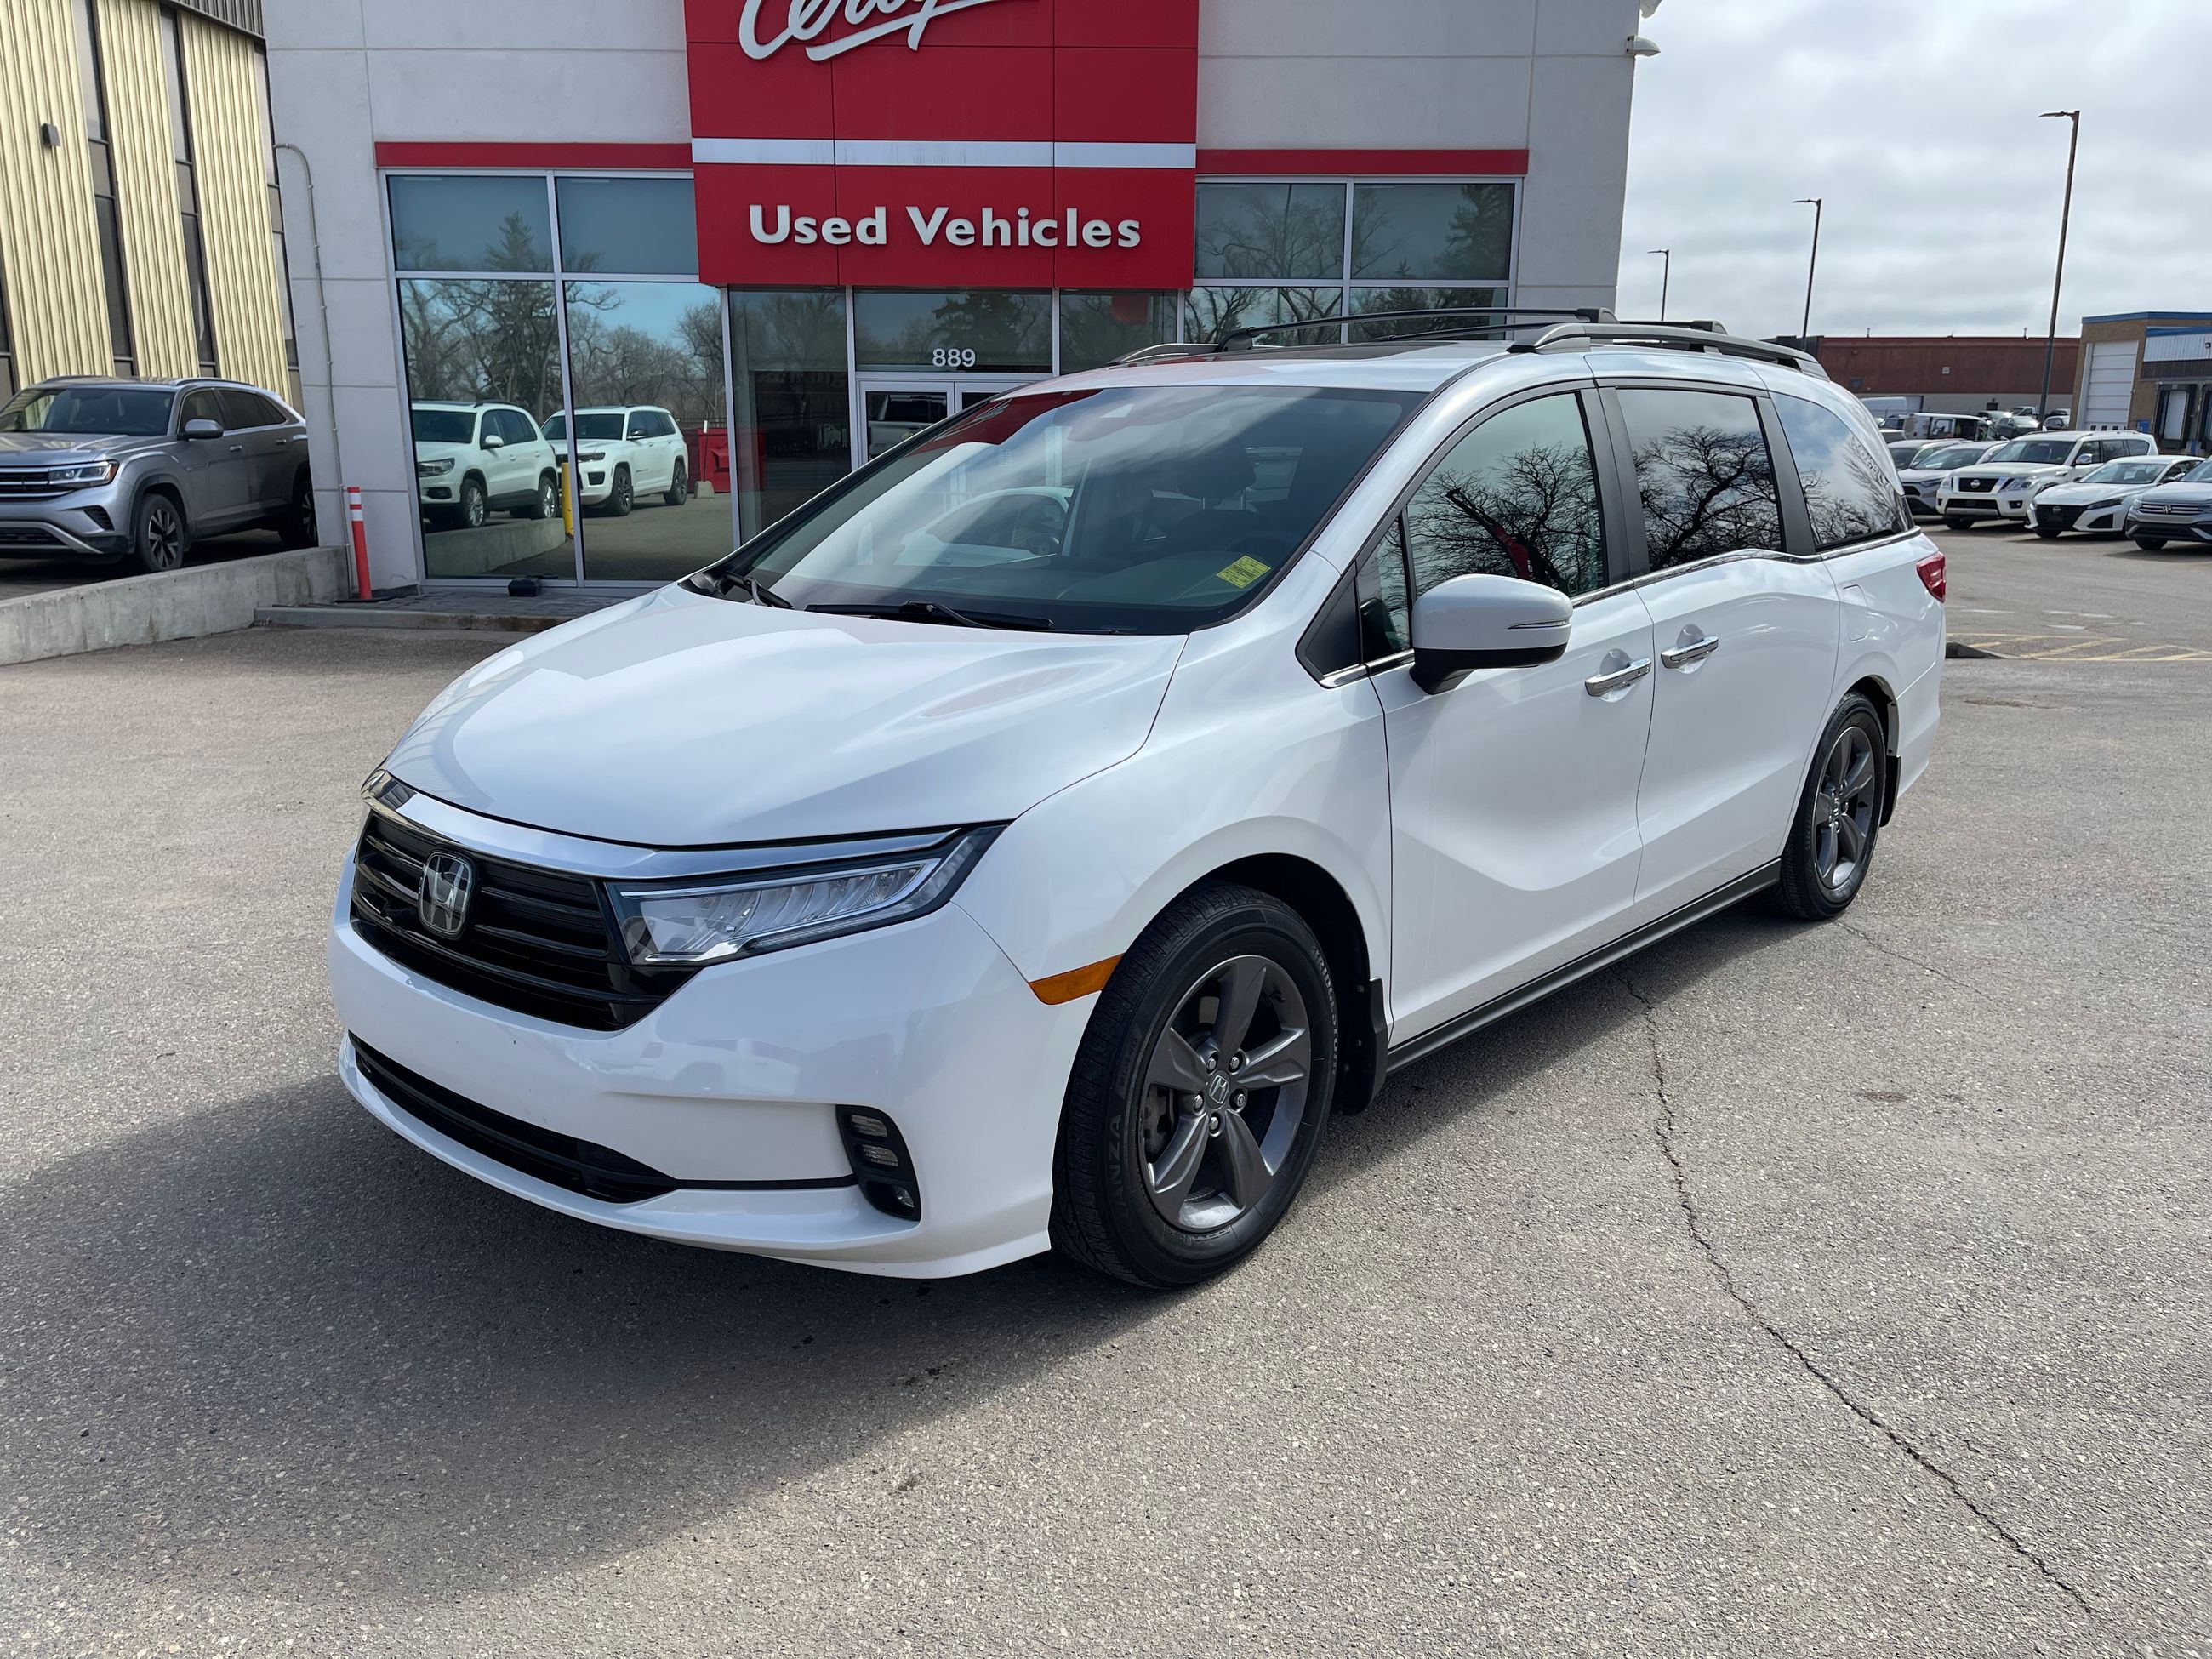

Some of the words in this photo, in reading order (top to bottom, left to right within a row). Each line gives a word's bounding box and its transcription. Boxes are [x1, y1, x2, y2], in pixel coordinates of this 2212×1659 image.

[749, 204, 887, 245] Used
[905, 205, 1141, 248] Vehicles
[932, 348, 976, 368] 889
